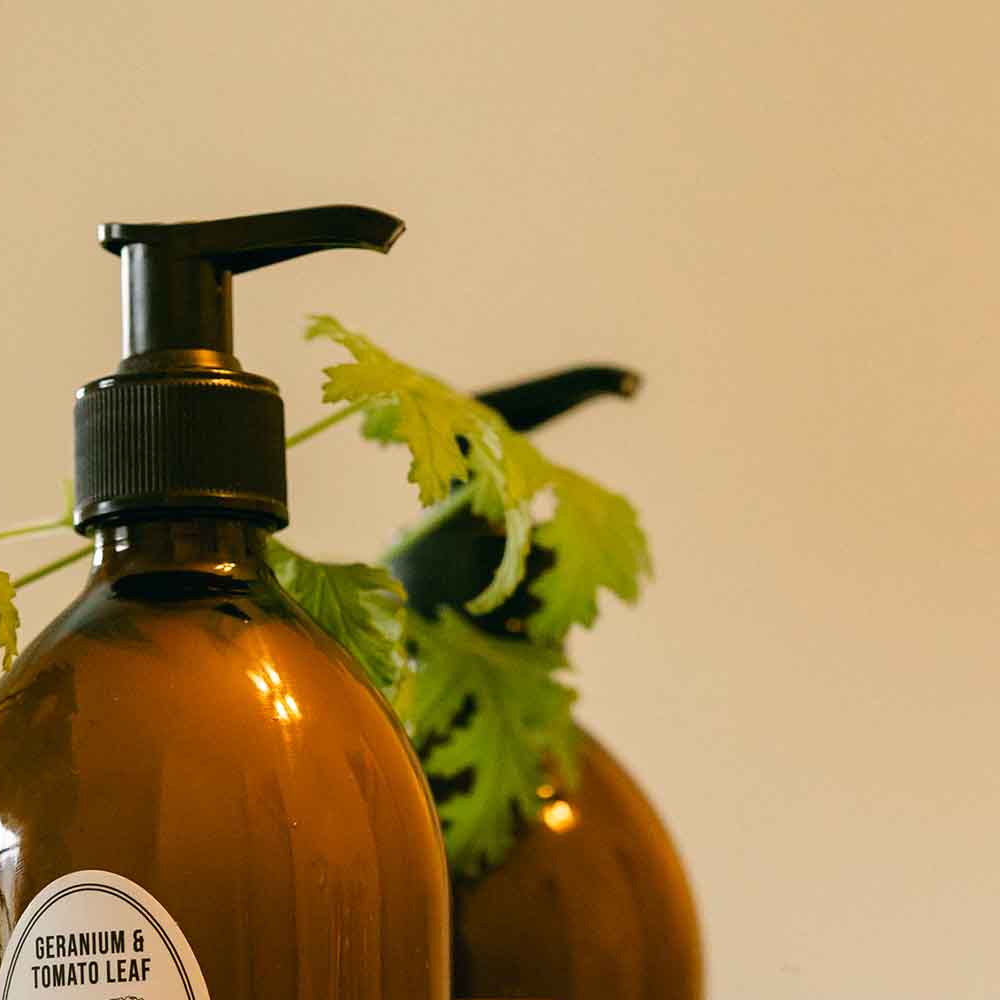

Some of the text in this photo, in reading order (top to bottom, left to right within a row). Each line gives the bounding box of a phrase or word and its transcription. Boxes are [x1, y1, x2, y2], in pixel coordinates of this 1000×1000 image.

[35, 929, 145, 960] GERANIUM &
[31, 958, 151, 989] TOMATO LEAF
